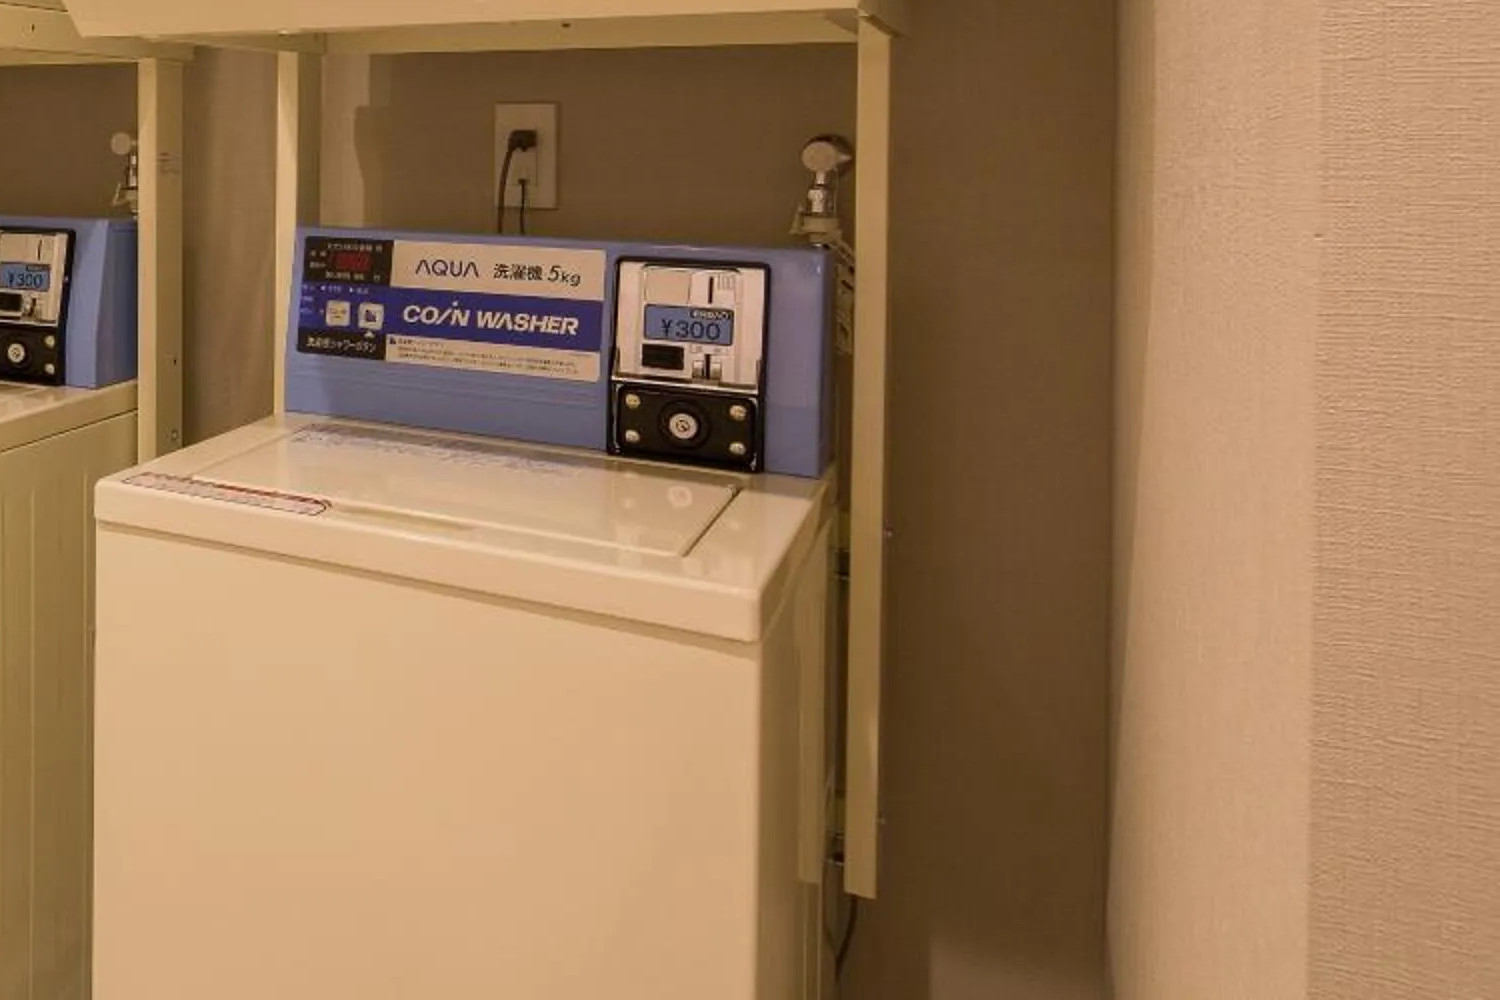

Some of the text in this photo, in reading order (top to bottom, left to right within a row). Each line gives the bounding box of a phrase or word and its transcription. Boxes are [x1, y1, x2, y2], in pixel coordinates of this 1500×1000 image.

[415, 258, 479, 279] AQUA
[493, 263, 582, 288] 洗濯機 5kg
[403, 300, 580, 337] COIN WASHER
[660, 318, 721, 341] ¥300
